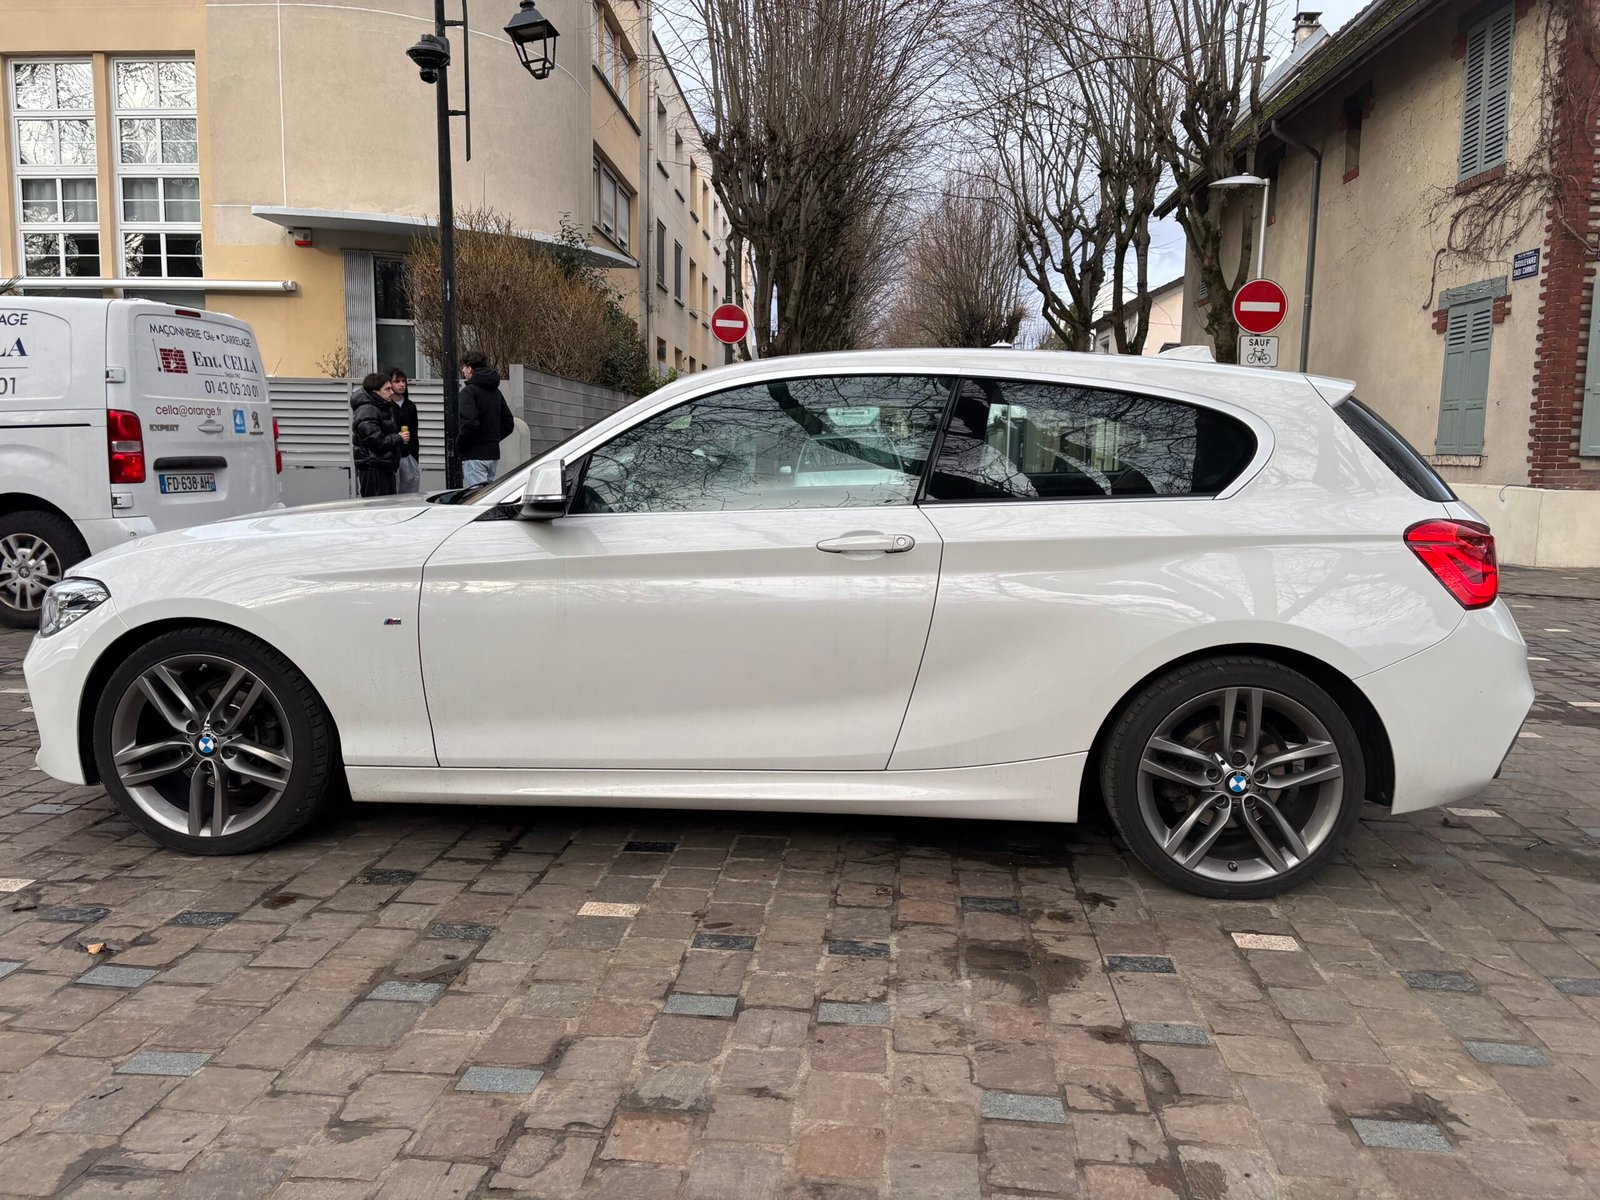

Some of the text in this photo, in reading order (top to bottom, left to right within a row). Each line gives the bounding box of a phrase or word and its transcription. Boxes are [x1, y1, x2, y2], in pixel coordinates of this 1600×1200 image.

[149, 323, 202, 340] MAÇONNERIE
[220, 333, 251, 348] CARRELAGE
[1248, 338, 1271, 347] SAUF
[192, 351, 258, 373] Ent. CELLA
[204, 380, 260, 398] 01 43 05 20 01
[155, 404, 222, 419] cella@orange.fr
[149, 424, 180, 432] EXPERT
